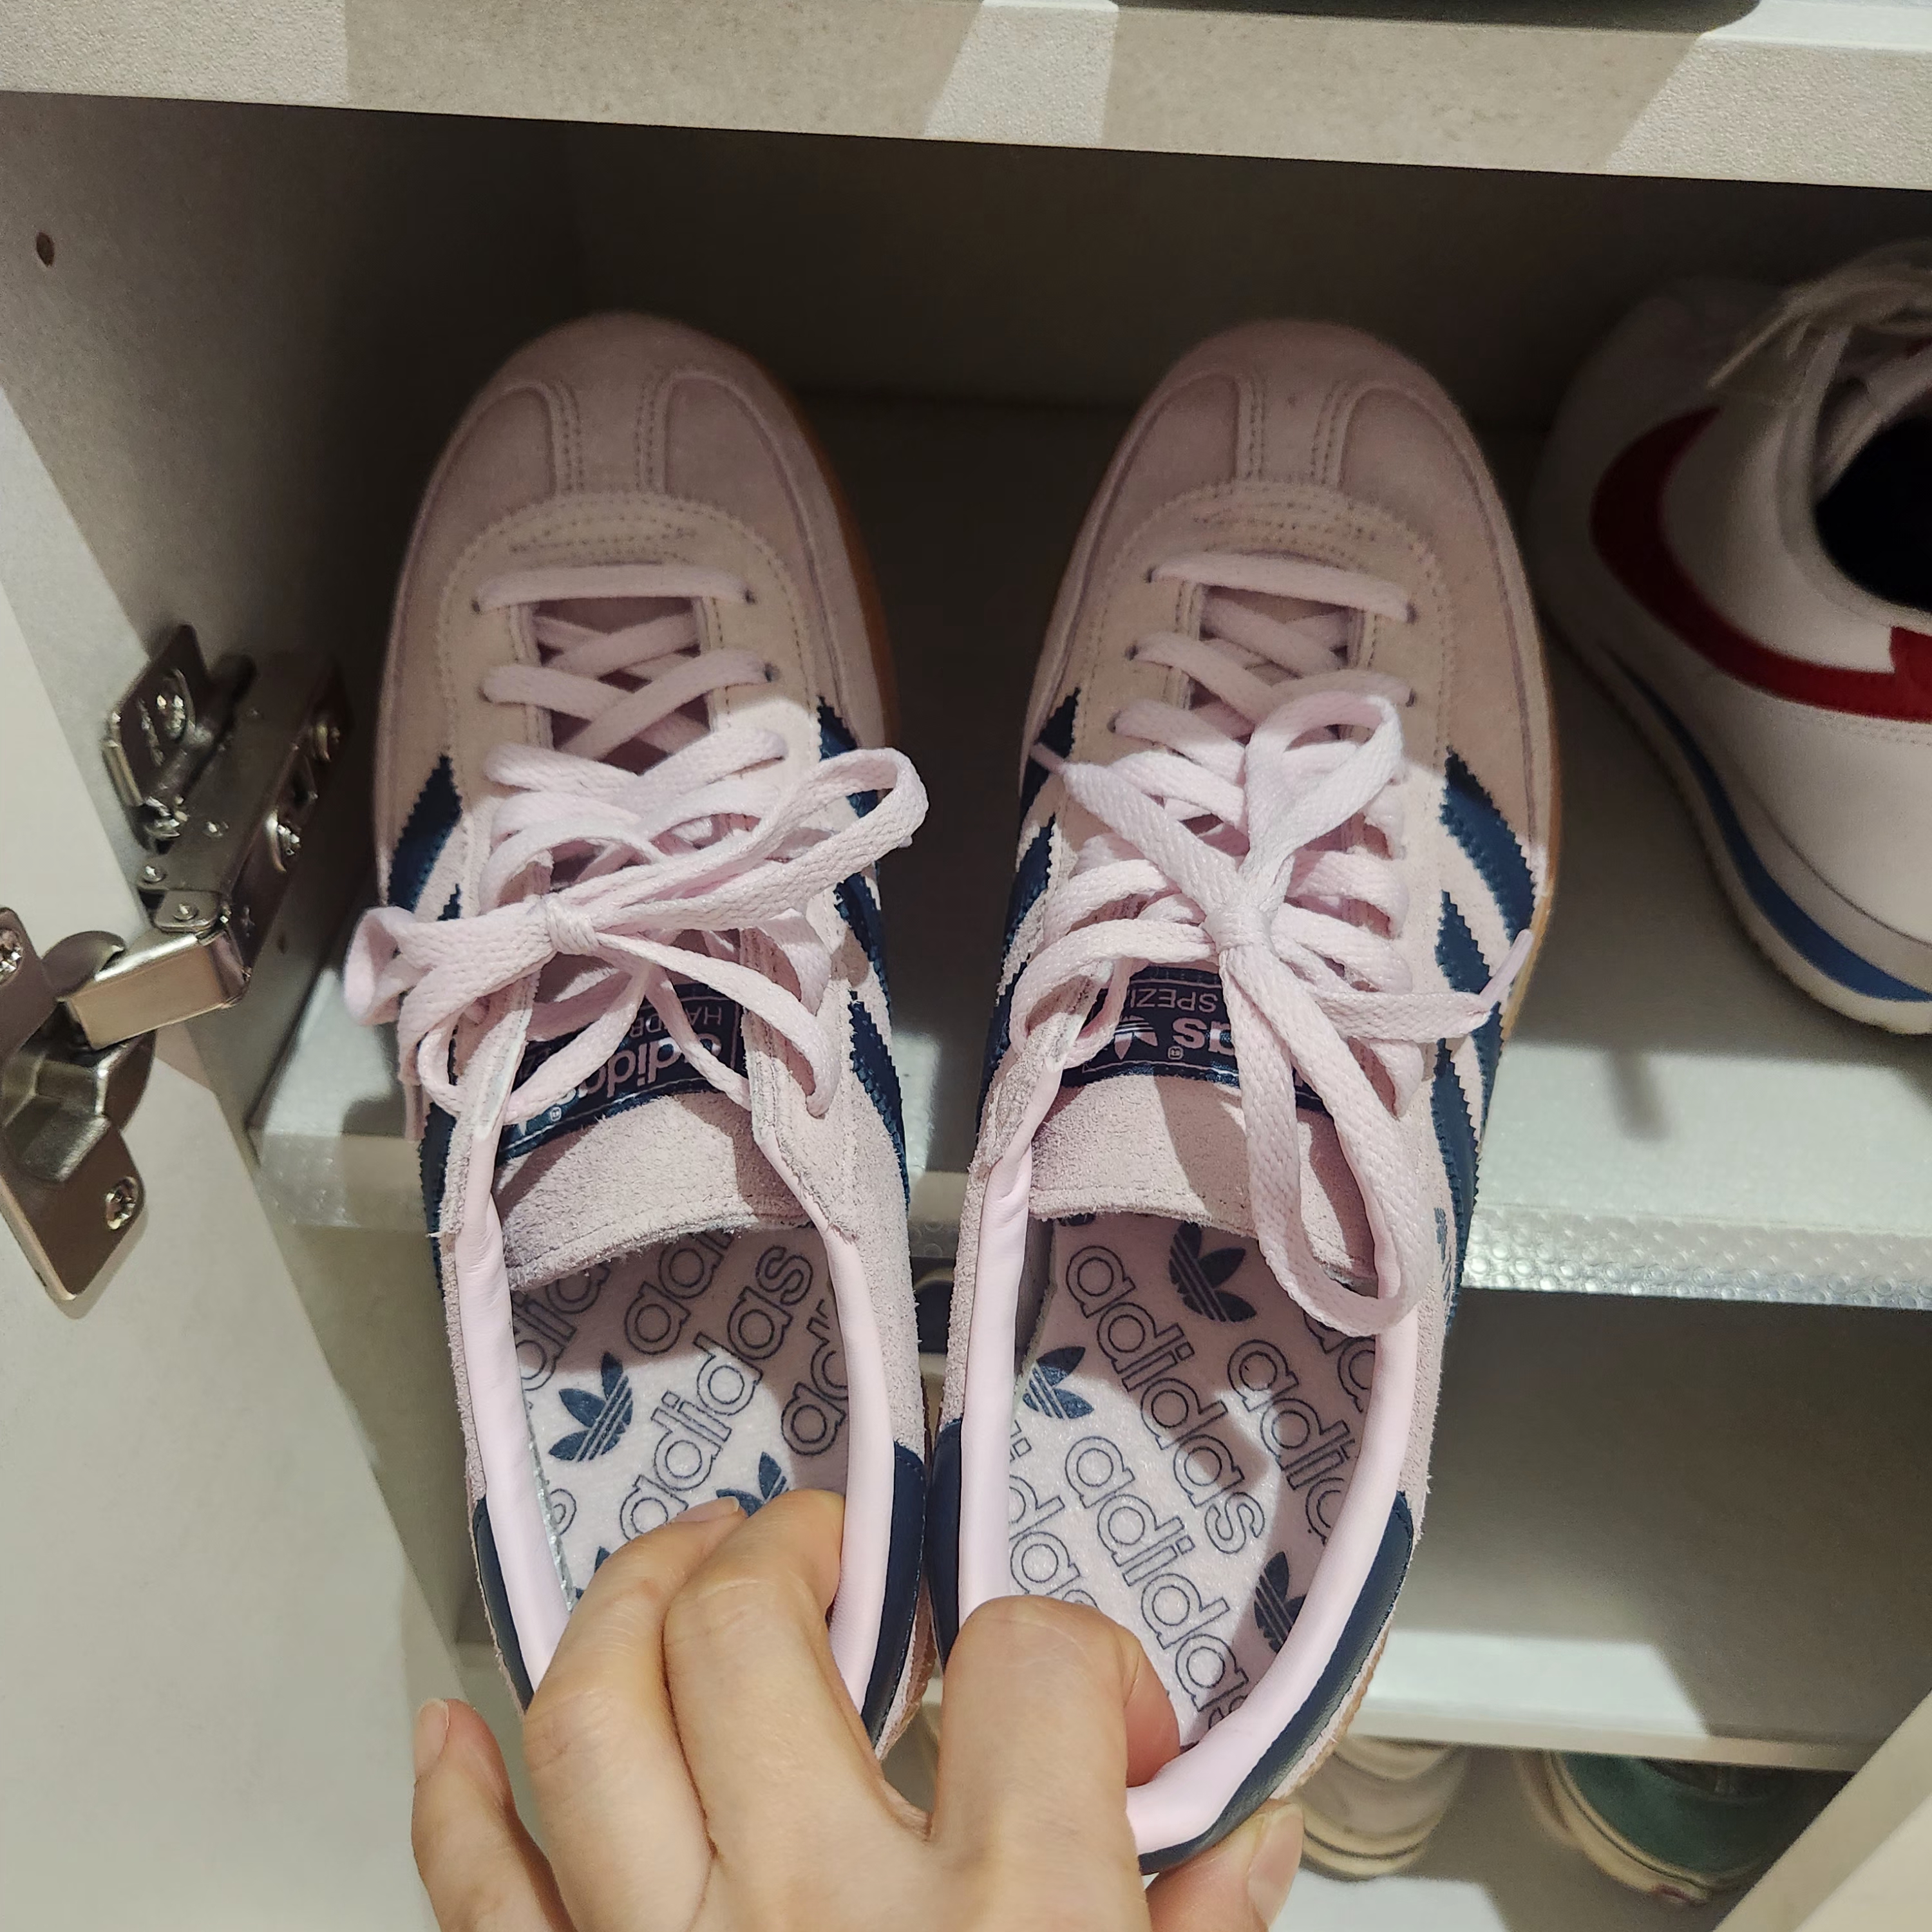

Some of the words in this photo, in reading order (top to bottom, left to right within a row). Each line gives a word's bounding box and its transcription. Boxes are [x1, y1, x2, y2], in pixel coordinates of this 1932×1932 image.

[1127, 989, 1218, 1013] SPEZI
[620, 1245, 813, 1540] adidas
[1065, 1245, 1265, 1554] adidas
[1065, 1435, 1249, 1730] adida
